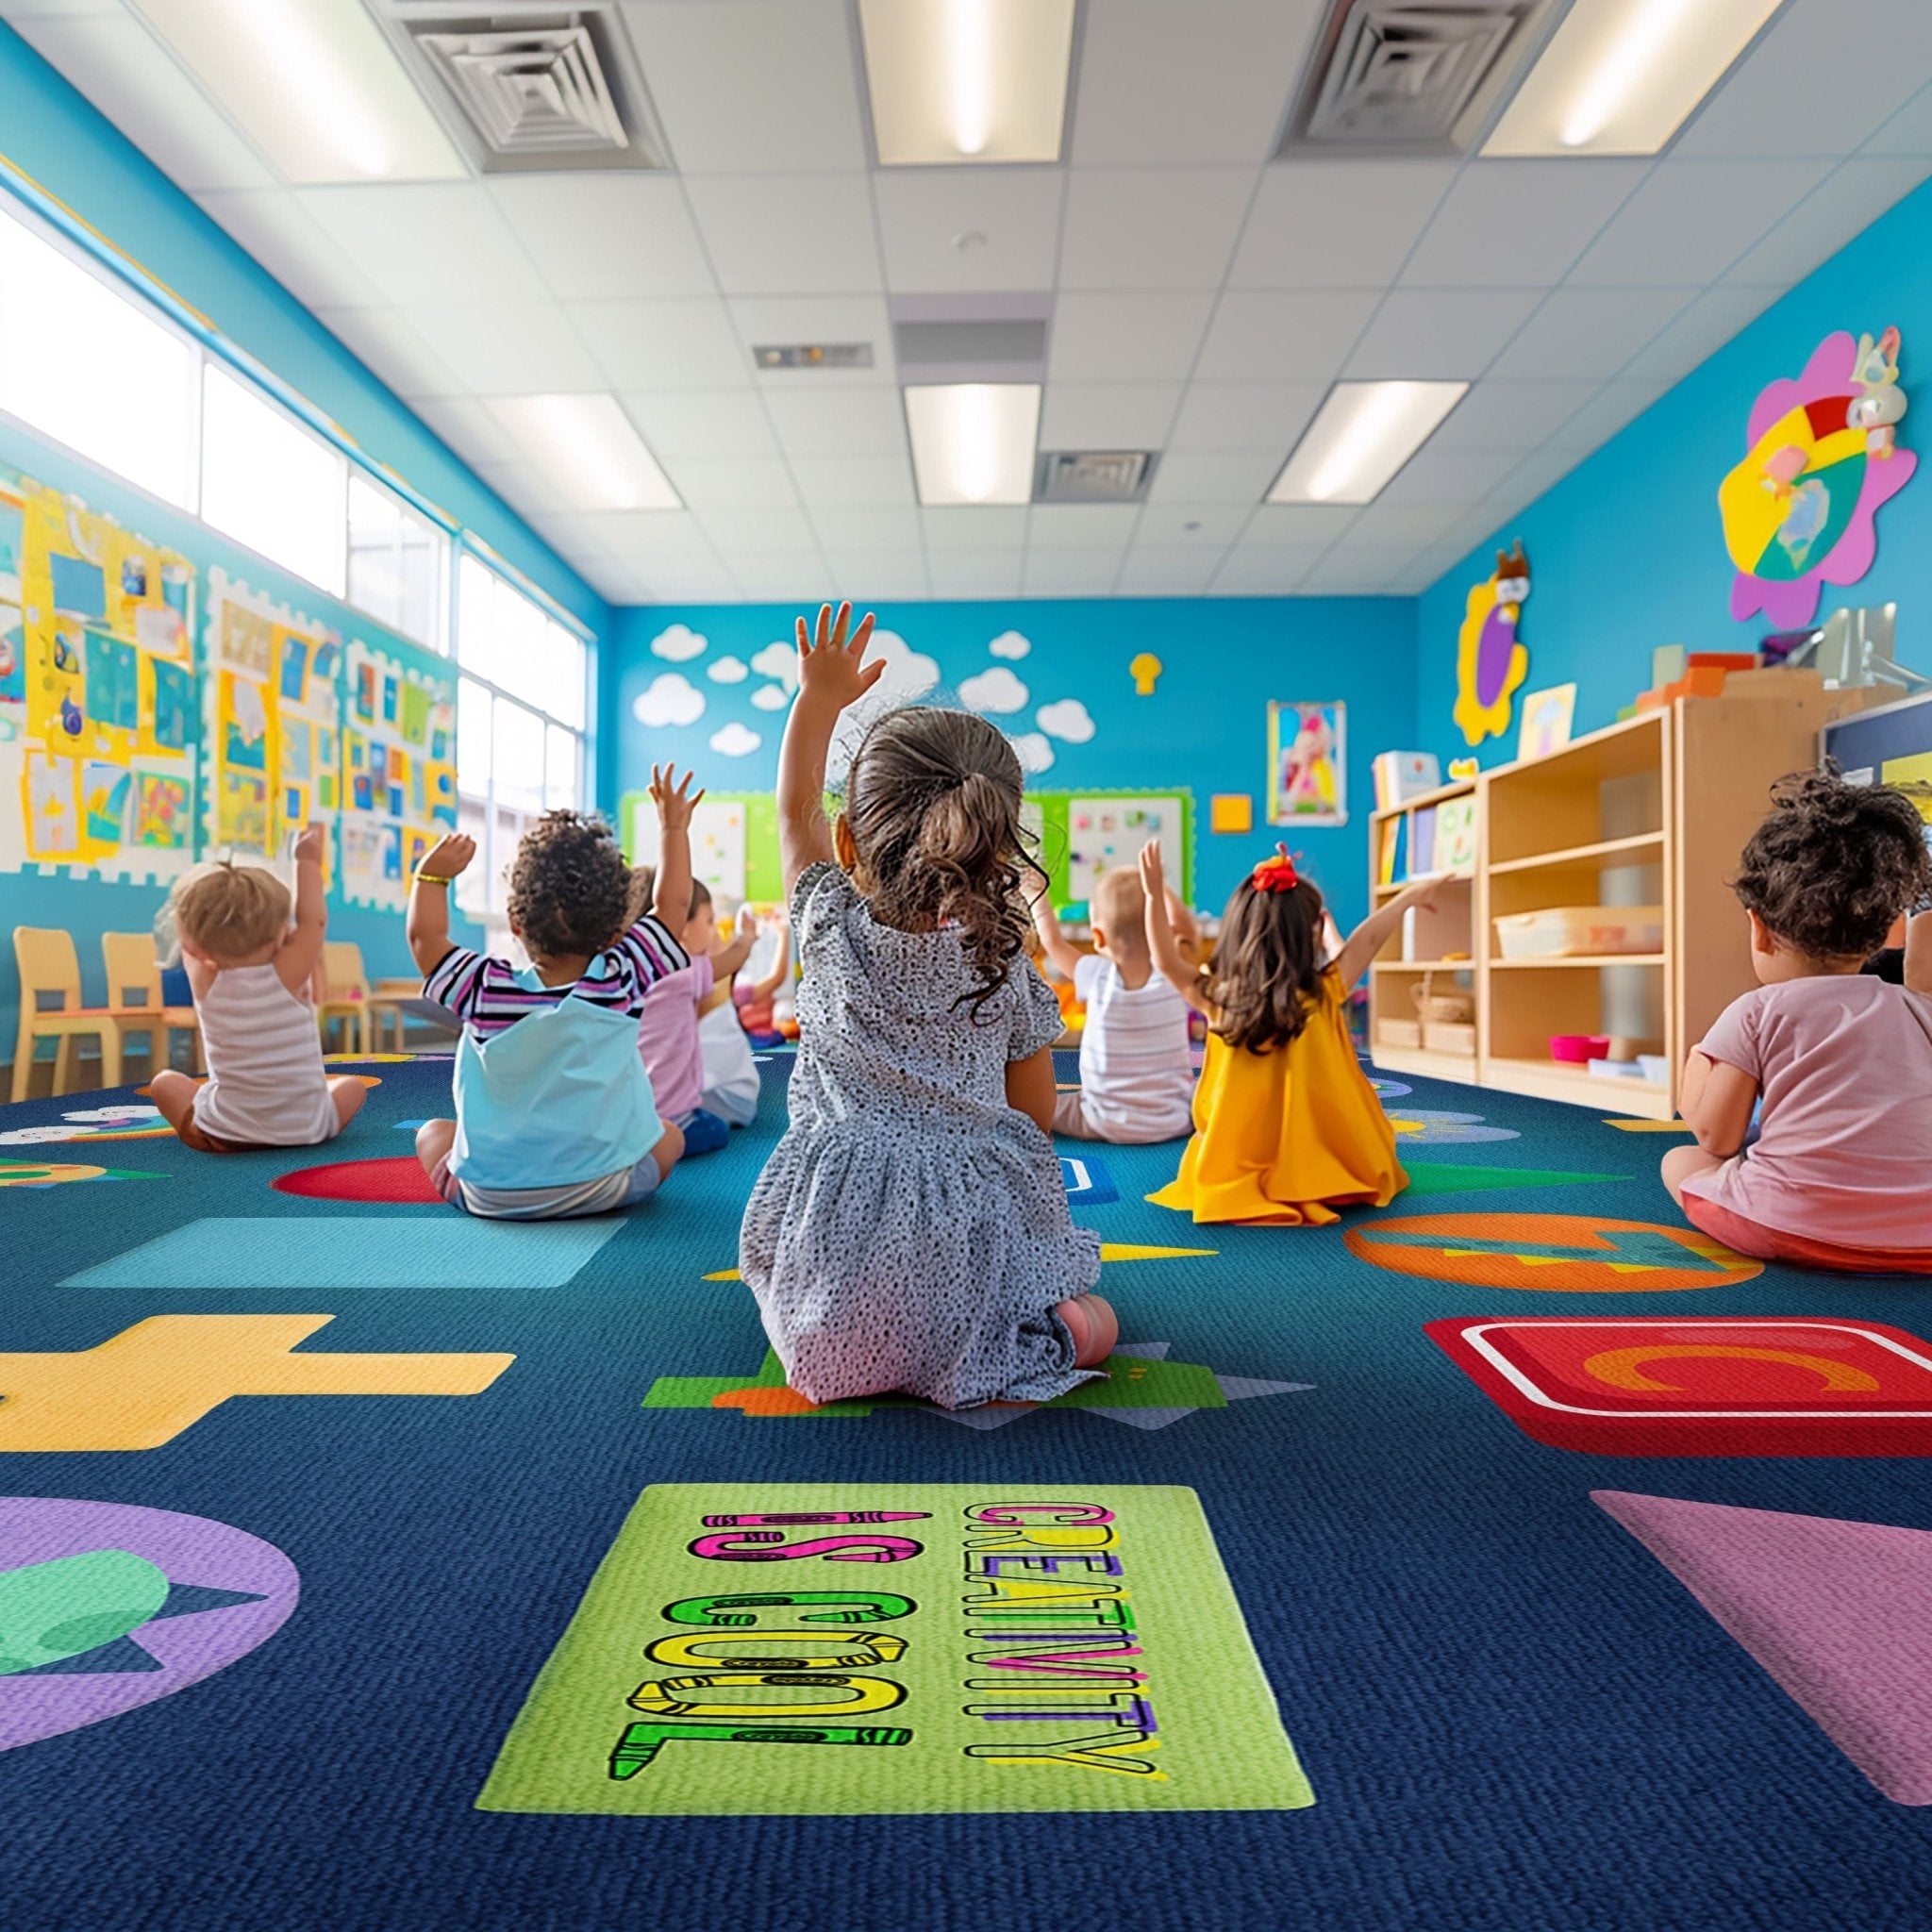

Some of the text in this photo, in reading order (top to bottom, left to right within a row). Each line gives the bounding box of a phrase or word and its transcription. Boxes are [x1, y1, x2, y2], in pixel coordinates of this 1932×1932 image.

[608, 1511, 933, 1781] IS COOL
[962, 1501, 1169, 1781] CREATIVITY
